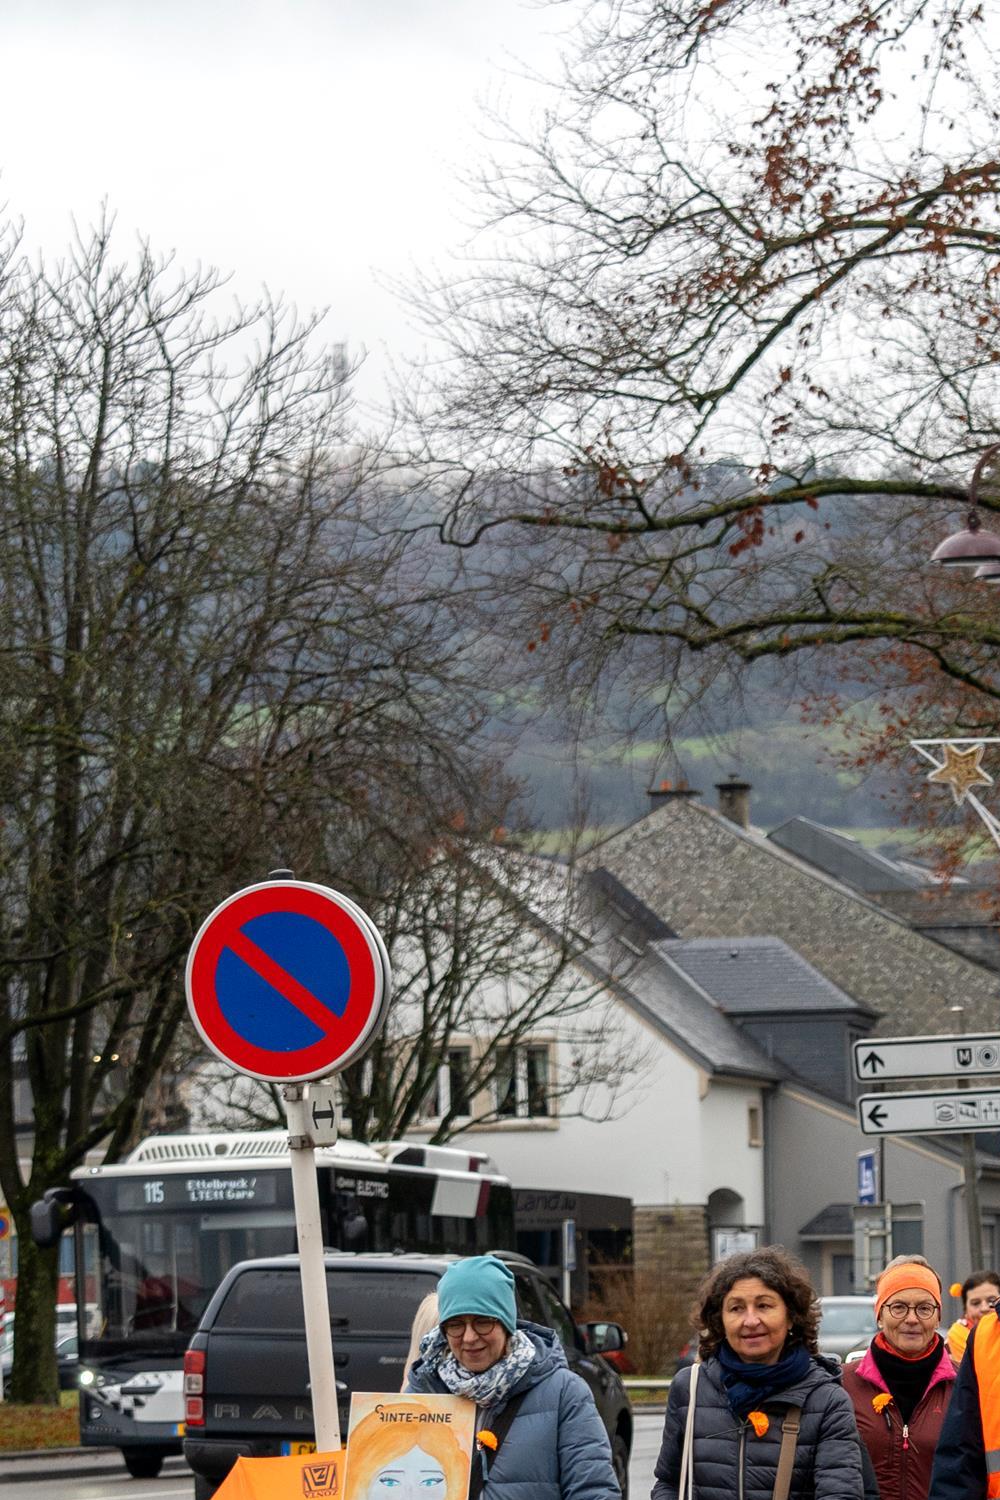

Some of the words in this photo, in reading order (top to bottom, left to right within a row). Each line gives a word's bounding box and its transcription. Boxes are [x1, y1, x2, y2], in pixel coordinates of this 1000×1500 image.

[144, 1181, 165, 1203] 115
[186, 1178, 249, 1191] Ettelbruck
[356, 1179, 389, 1199] ELECTRIC
